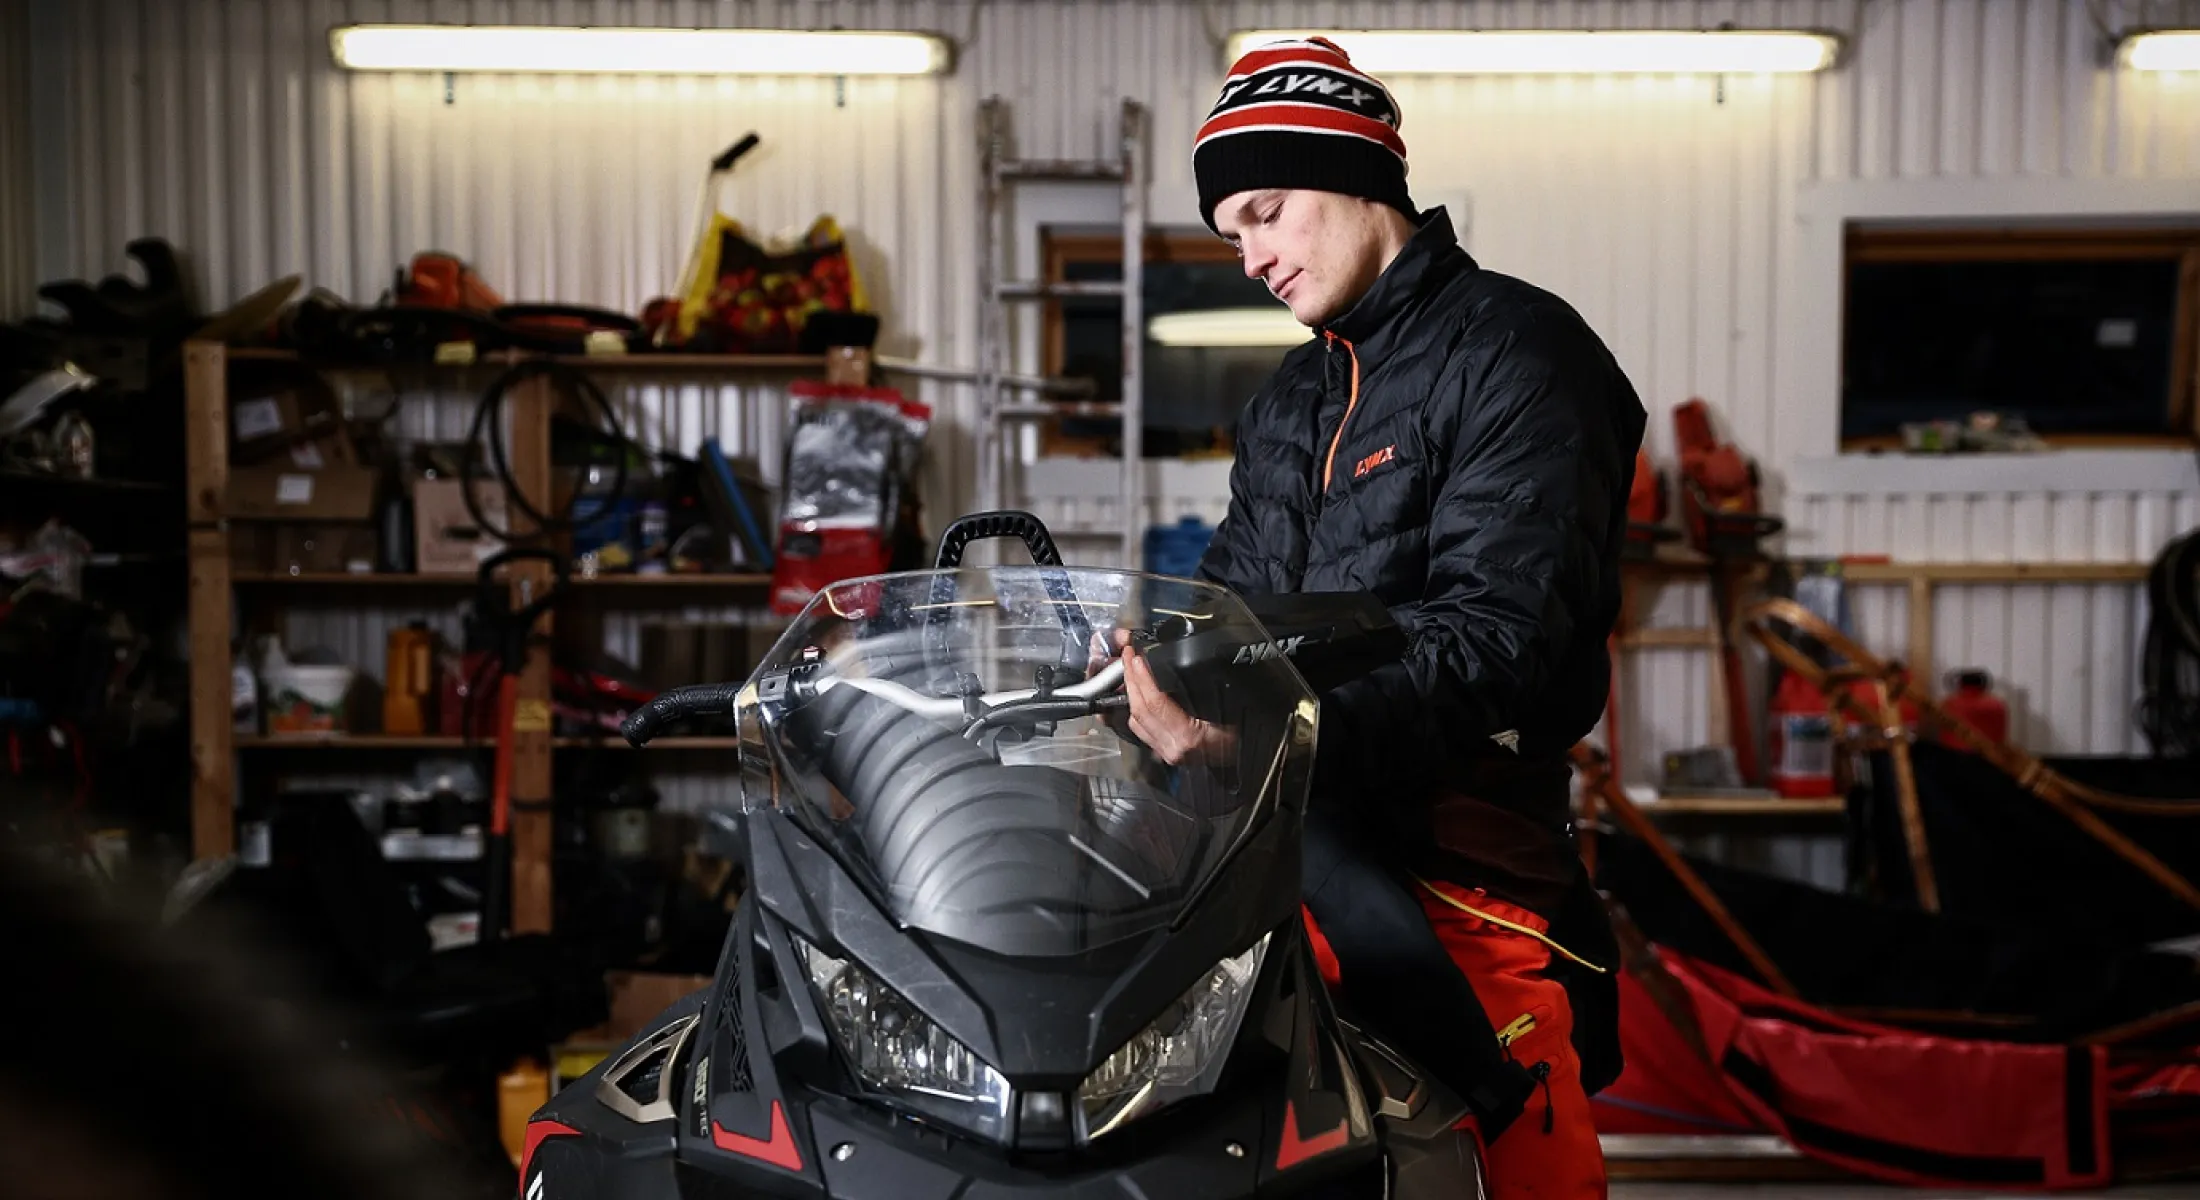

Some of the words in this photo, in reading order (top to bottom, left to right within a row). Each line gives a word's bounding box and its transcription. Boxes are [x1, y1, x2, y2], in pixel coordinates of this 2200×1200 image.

[1249, 74, 1375, 107] LYNX
[1354, 444, 1397, 478] LYNX
[1232, 635, 1305, 665] LYNX
